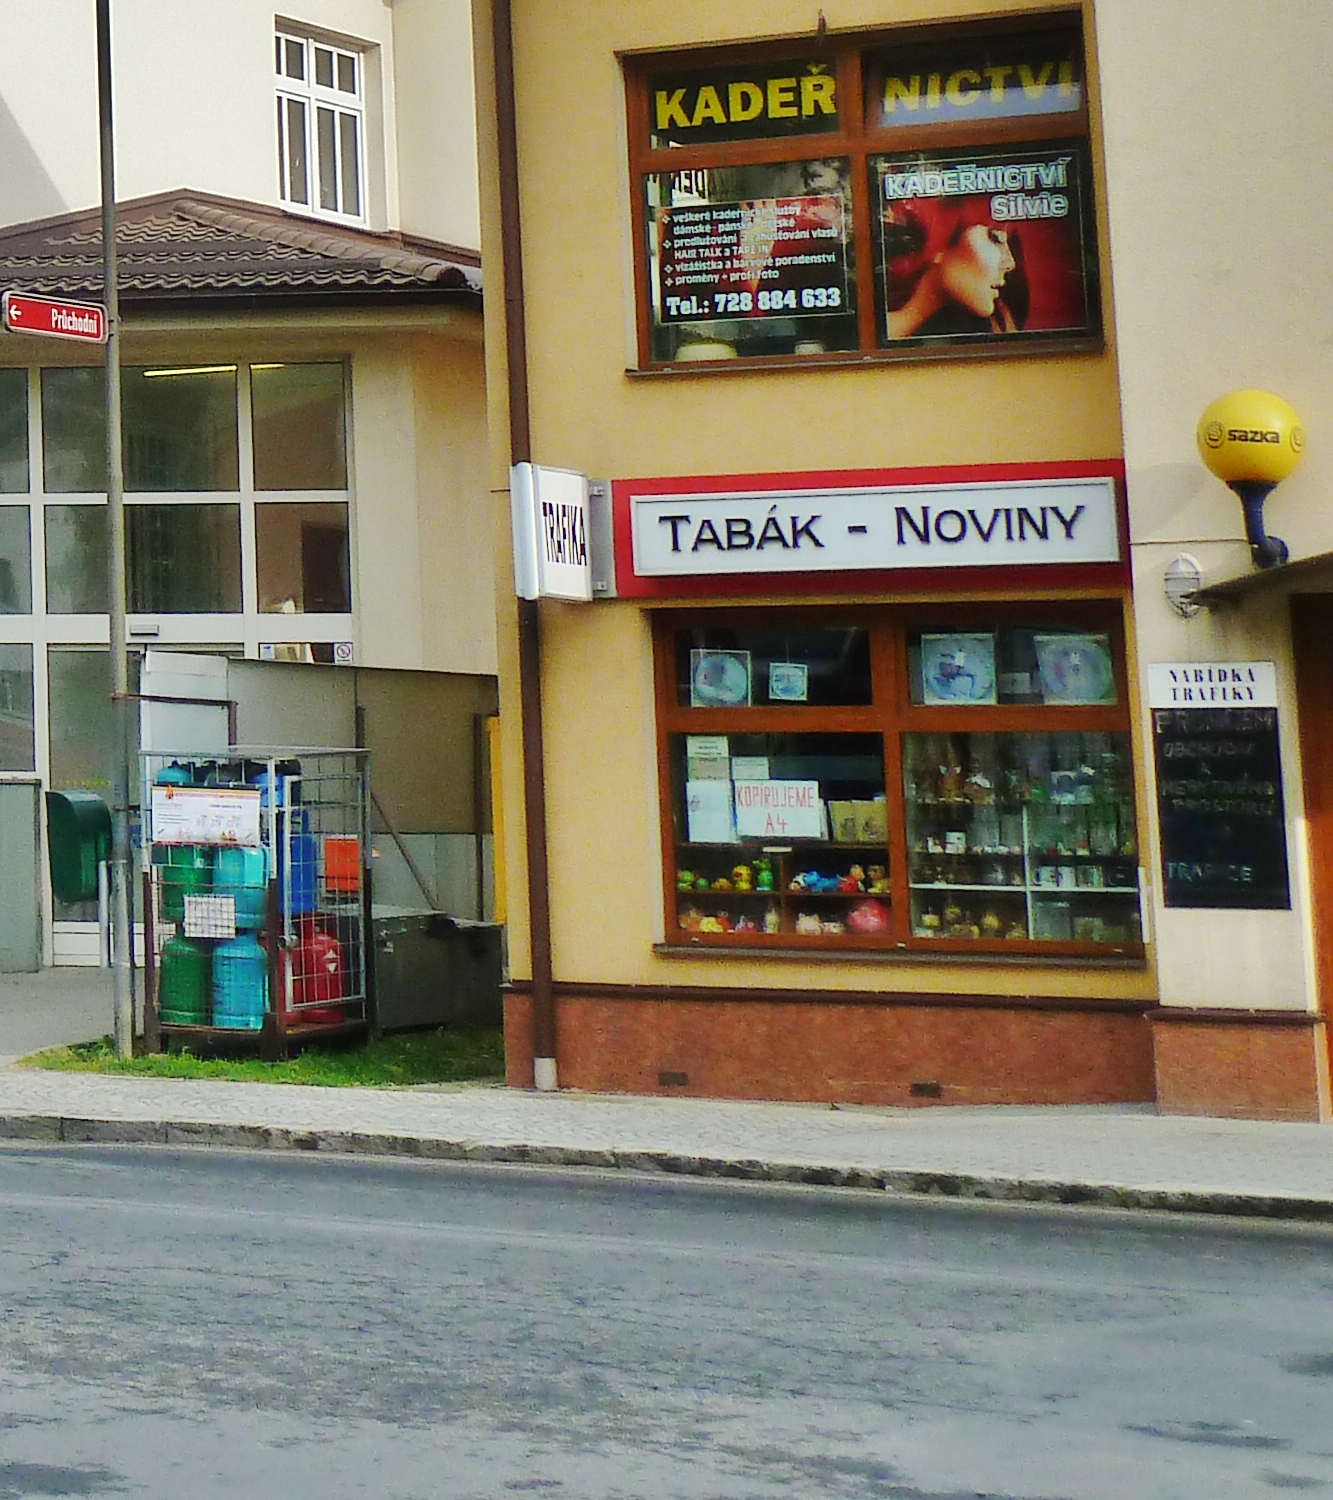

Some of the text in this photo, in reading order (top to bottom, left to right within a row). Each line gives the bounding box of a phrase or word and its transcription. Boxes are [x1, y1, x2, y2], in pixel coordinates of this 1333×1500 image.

[655, 64, 836, 130] KADEŘ
[885, 157, 1072, 199] KADEŘNICTVÍ
[992, 192, 1068, 220] Silvie
[699, 246, 722, 258] TALK
[666, 286, 841, 316] Tel.: 728 884 633
[51, 308, 97, 334] Průchodní
[1228, 429, 1280, 444] sazka
[542, 501, 587, 566] TRAFIKA
[658, 504, 825, 553] TABÁK
[894, 505, 1086, 546] NOVINY
[1169, 667, 1255, 683] NABÍDKA
[1171, 687, 1255, 701] TRAFIKY
